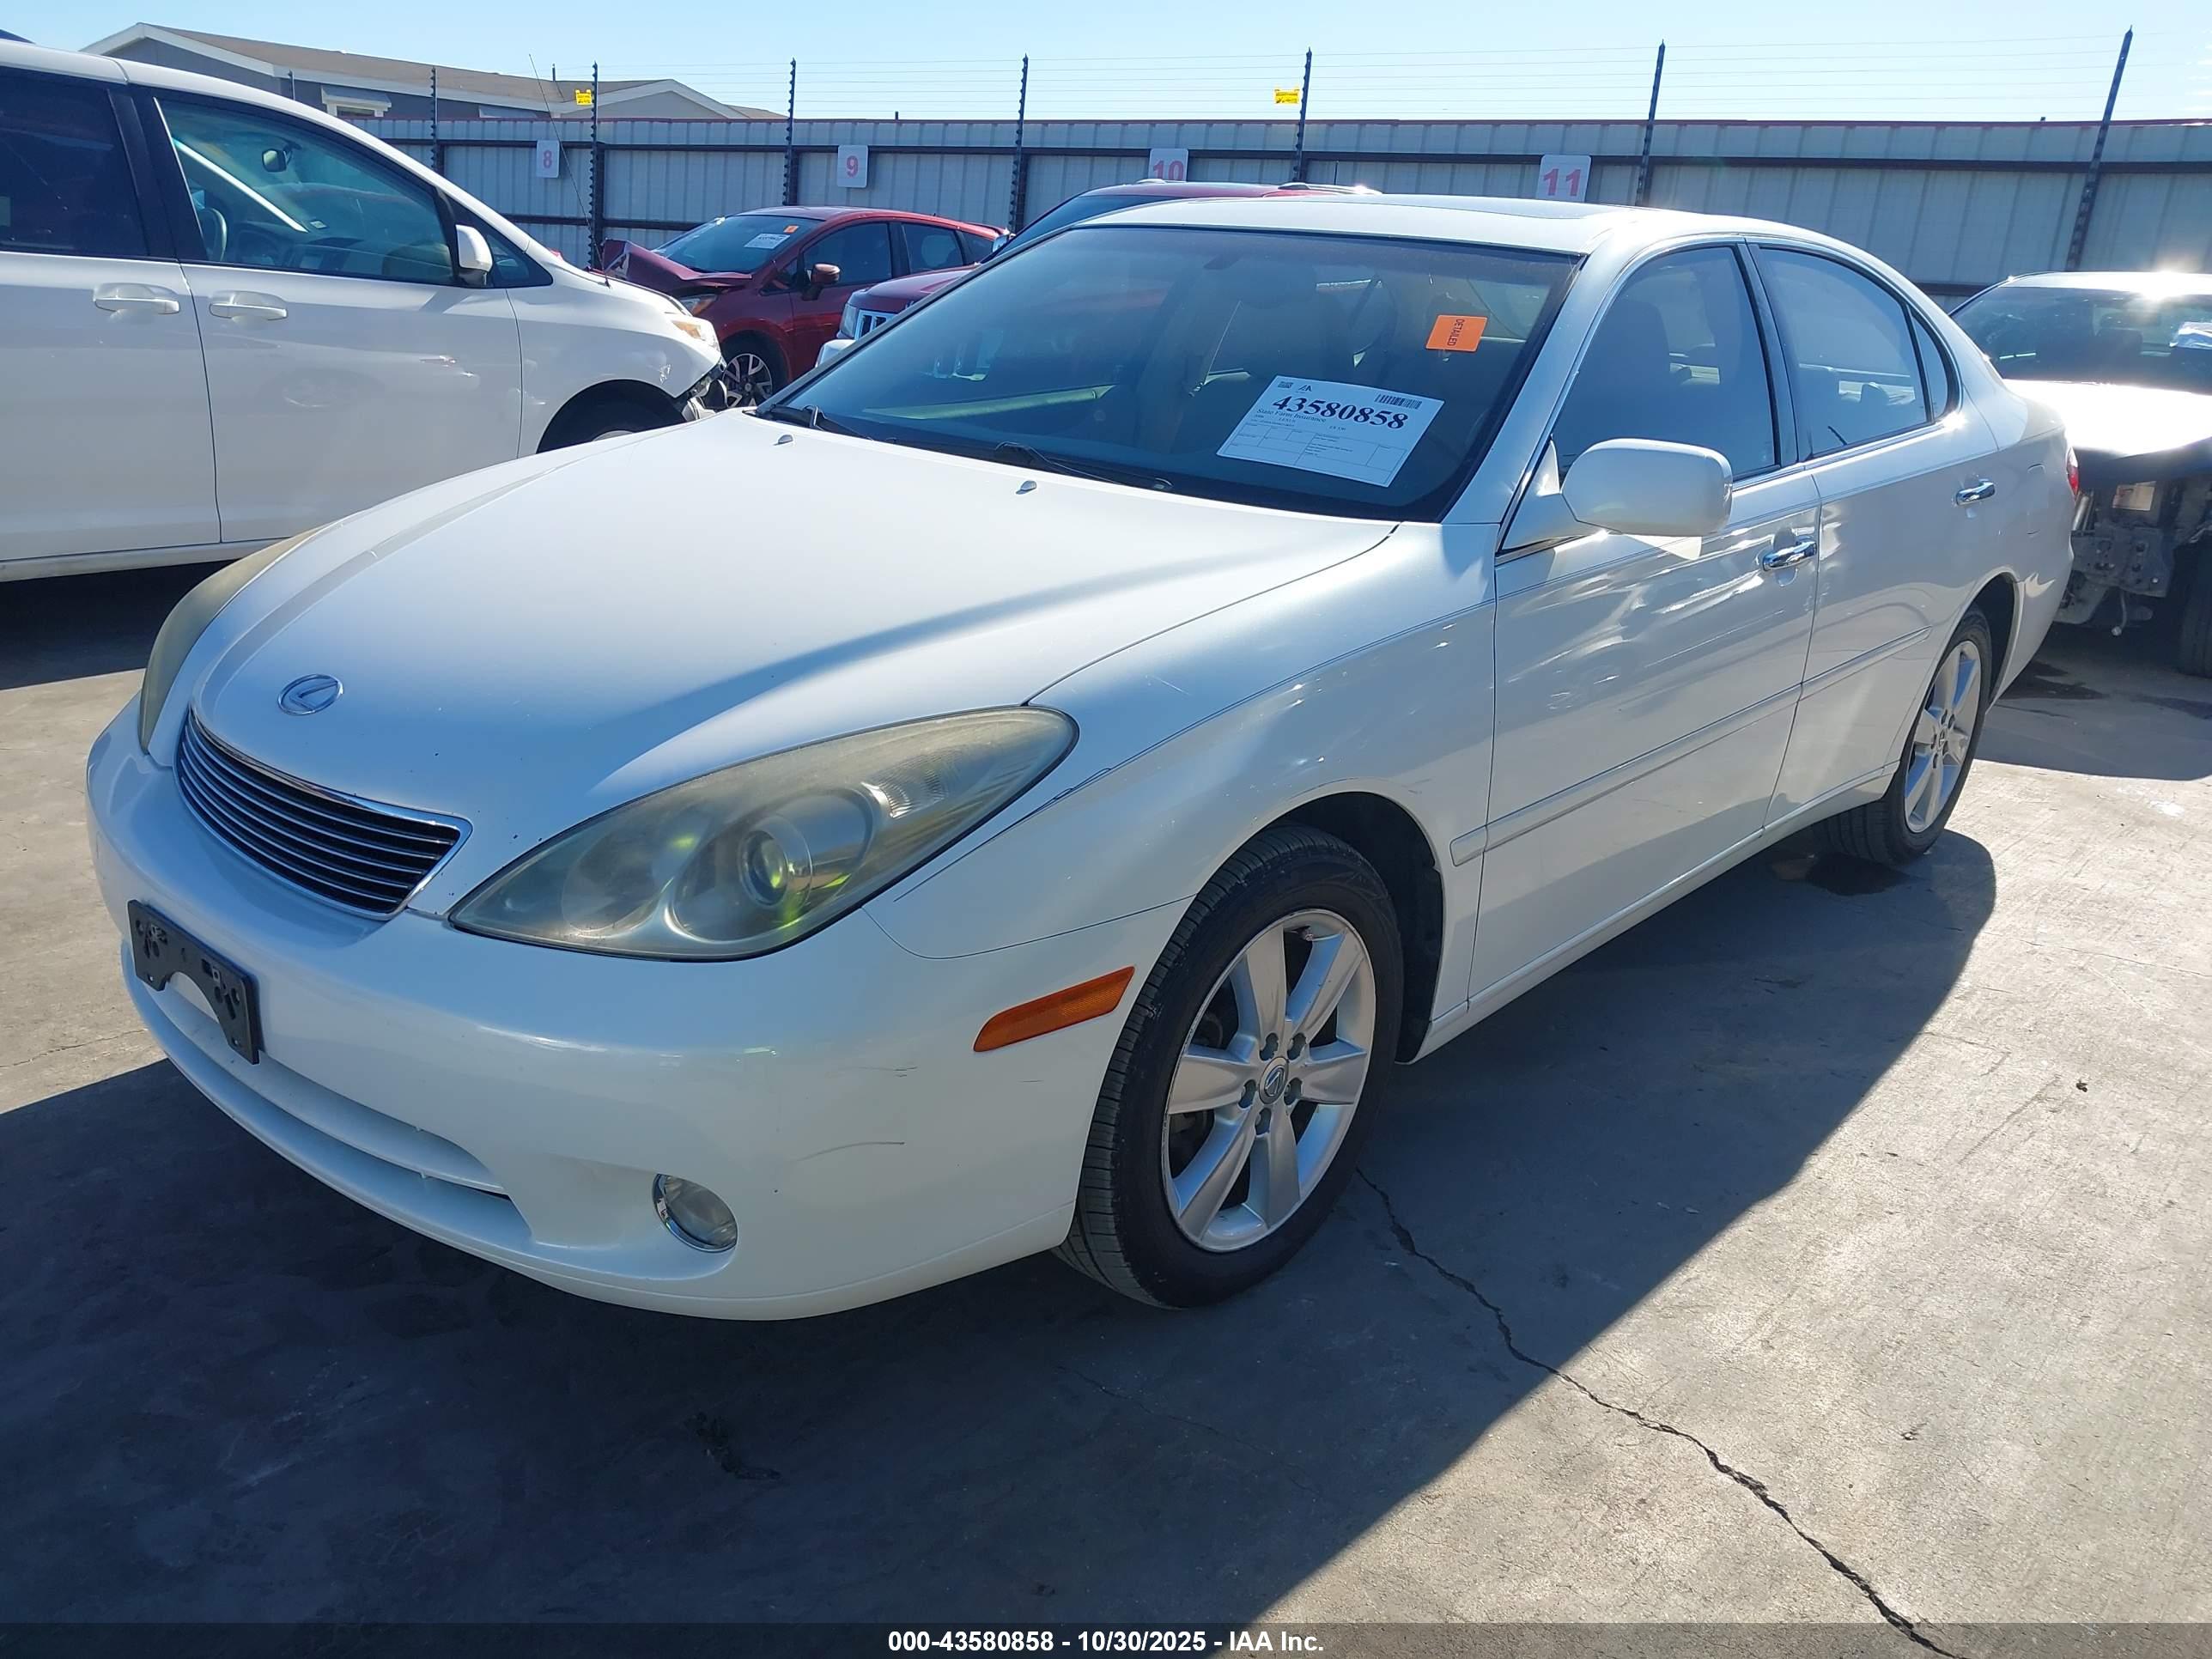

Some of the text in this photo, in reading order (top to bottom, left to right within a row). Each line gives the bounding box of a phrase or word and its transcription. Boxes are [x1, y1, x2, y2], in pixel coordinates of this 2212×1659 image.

[543, 149, 553, 168] 8
[847, 155, 859, 178] 9
[1152, 160, 1184, 180] 10
[1542, 168, 1583, 197] 11
[1447, 319, 1465, 346] DETAILED
[1256, 408, 1274, 417] State
[1274, 410, 1294, 420] Farm
[1295, 413, 1327, 422] Insurance
[1273, 396, 1409, 429] 43580858
